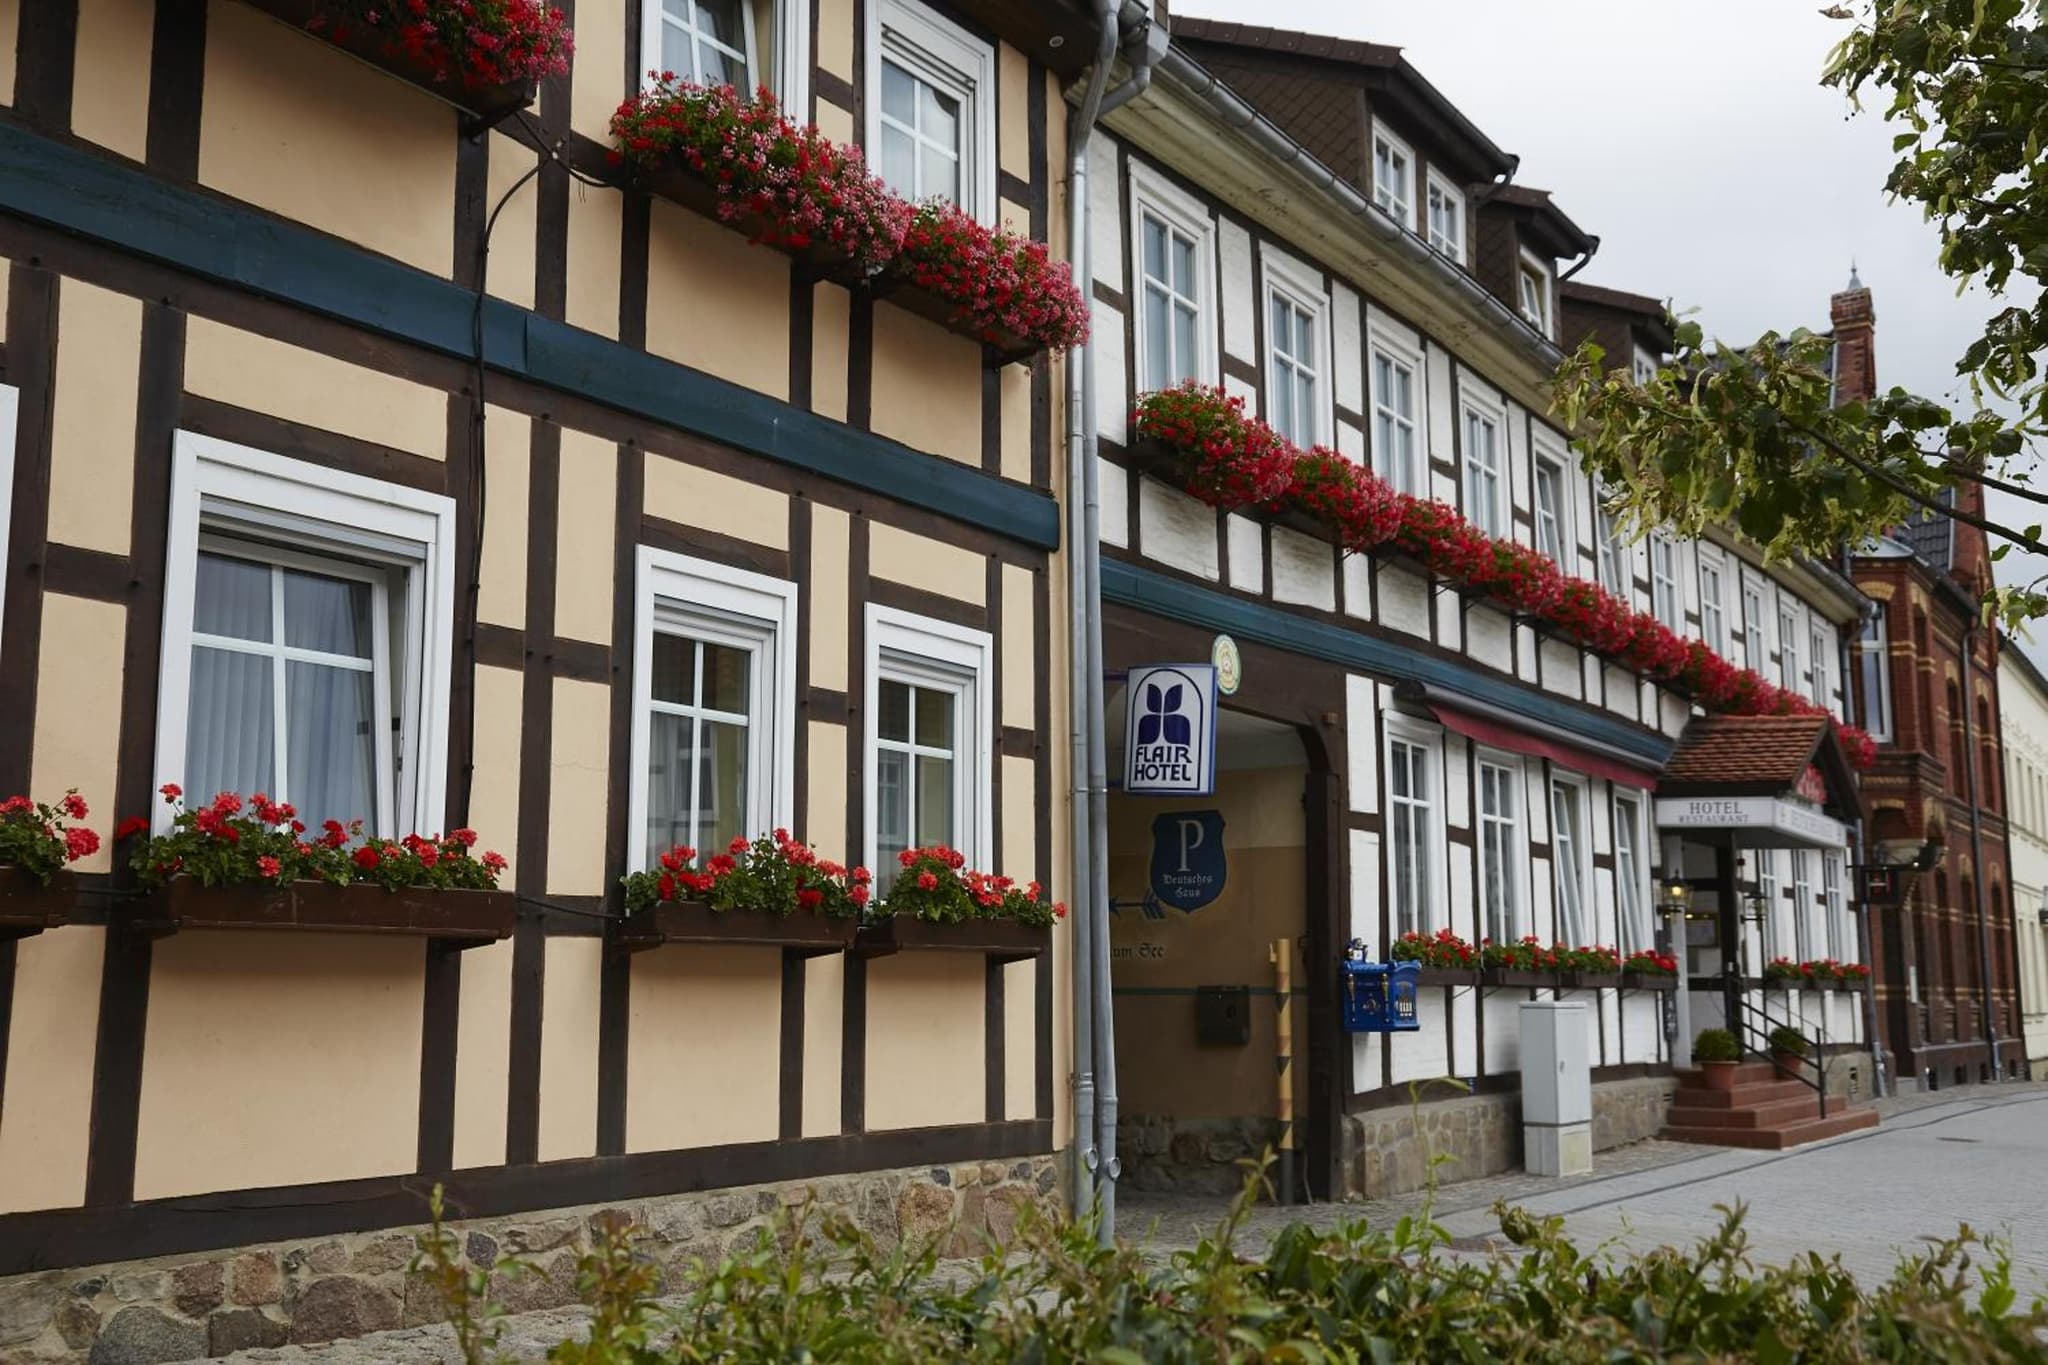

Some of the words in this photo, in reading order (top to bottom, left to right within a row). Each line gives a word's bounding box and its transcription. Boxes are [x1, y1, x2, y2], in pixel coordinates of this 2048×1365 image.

[1135, 746, 1192, 763] FLAIR
[1134, 764, 1191, 781] HOTEL
[1689, 801, 1743, 815] HOTEL
[1176, 819, 1205, 872] P
